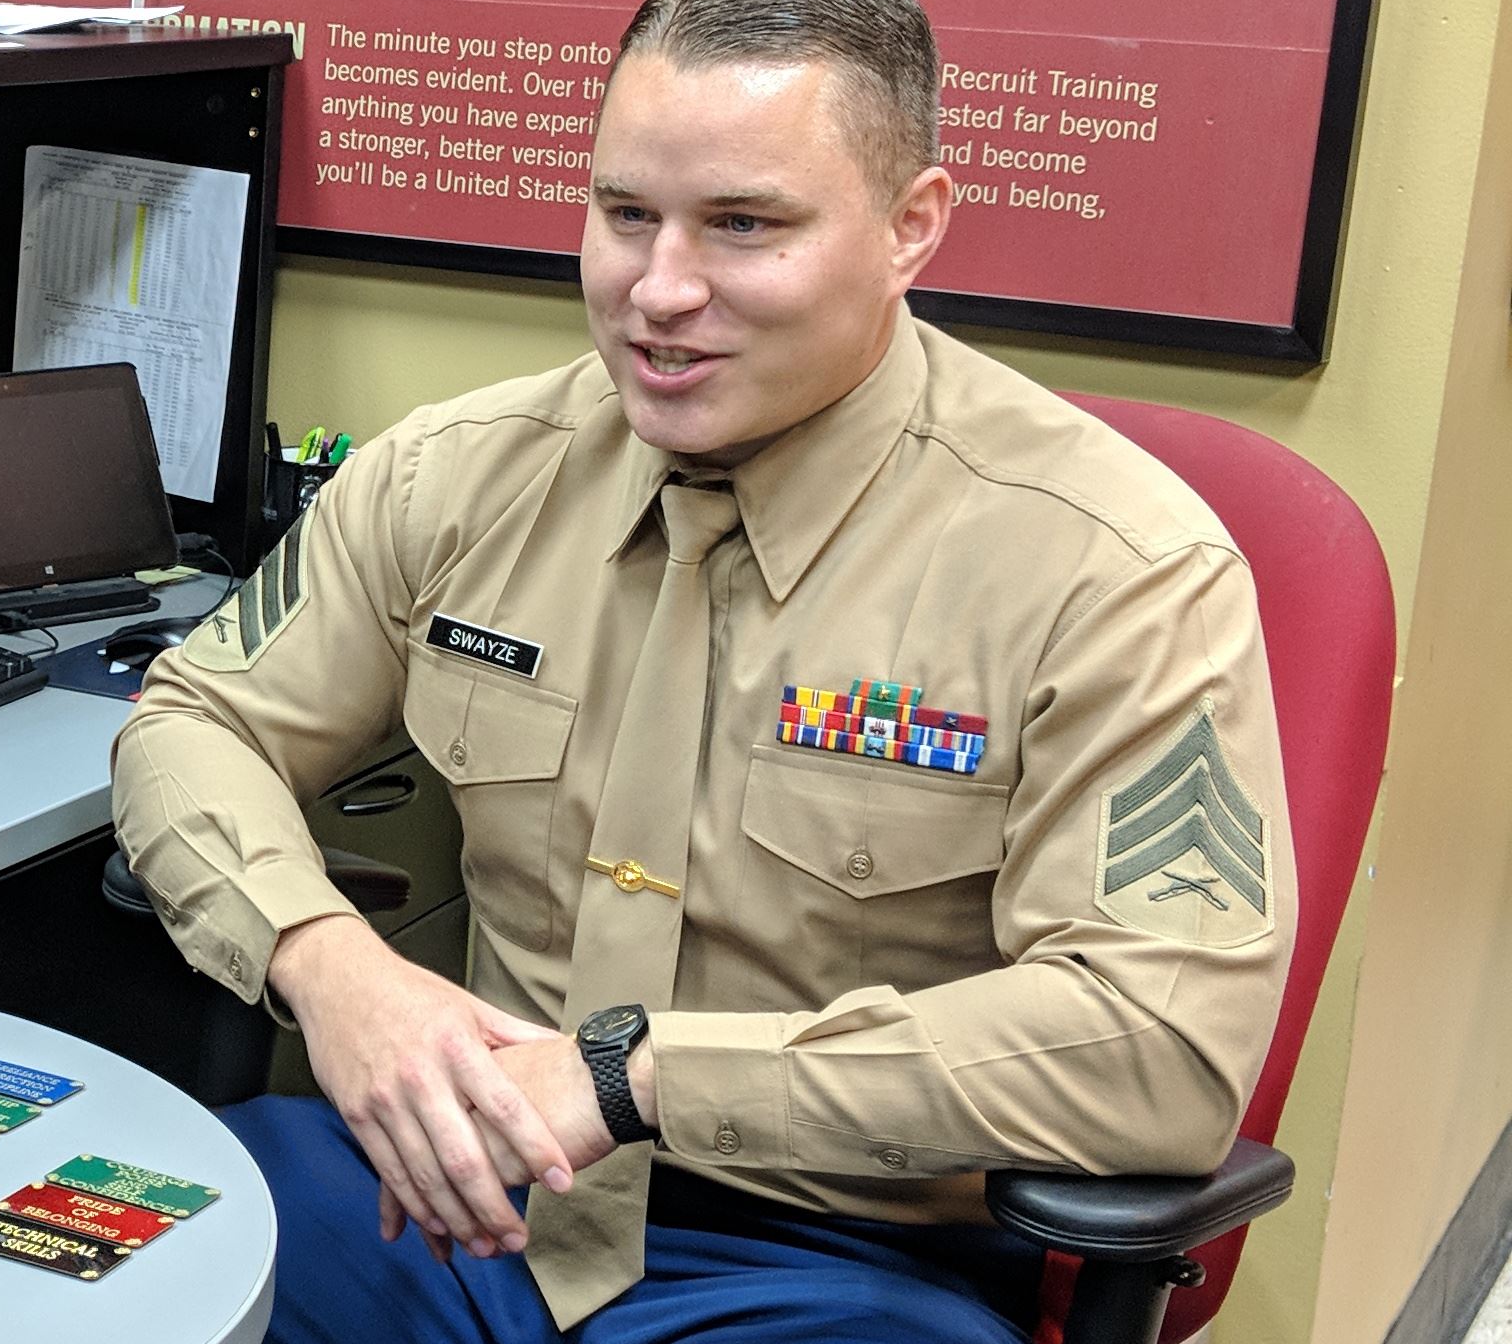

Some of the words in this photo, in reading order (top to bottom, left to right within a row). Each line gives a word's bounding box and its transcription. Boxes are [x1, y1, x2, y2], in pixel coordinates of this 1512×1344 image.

[326, 22, 367, 49] The
[373, 27, 451, 55] minute
[456, 36, 496, 61] you
[503, 36, 552, 66] step
[560, 41, 612, 65] onto
[940, 62, 1038, 95] Recruit
[1047, 69, 1159, 109] Training
[324, 57, 419, 87] becomes
[425, 66, 514, 94] evident.
[523, 71, 576, 98] Over
[582, 76, 606, 100] th
[937, 103, 1004, 131] ested
[1013, 105, 1051, 134] far
[1058, 109, 1158, 143] beyond
[321, 94, 415, 126] anything
[419, 103, 459, 128] you
[467, 102, 518, 129] have
[525, 110, 595, 138] experi
[938, 140, 973, 166] nd
[981, 141, 1087, 175] become
[315, 161, 374, 186] you'll
[381, 163, 408, 188] be
[414, 171, 428, 190] a
[435, 168, 510, 198] United
[517, 175, 589, 205] States
[319, 129, 332, 148] a
[338, 128, 430, 160] stronger,
[439, 134, 505, 162] better
[511, 143, 592, 170] version
[951, 182, 999, 207] you
[1008, 181, 1106, 220] belong,
[448, 627, 521, 665] SWAYZE
[0, 1064, 62, 1086] RELIANCE
[59, 1176, 175, 1214] CONFIDENCE
[67, 1194, 126, 1217] PRIDE
[71, 1208, 99, 1220] OF
[20, 1205, 121, 1239] BELONGING
[1, 1238, 62, 1261] SKILLS
